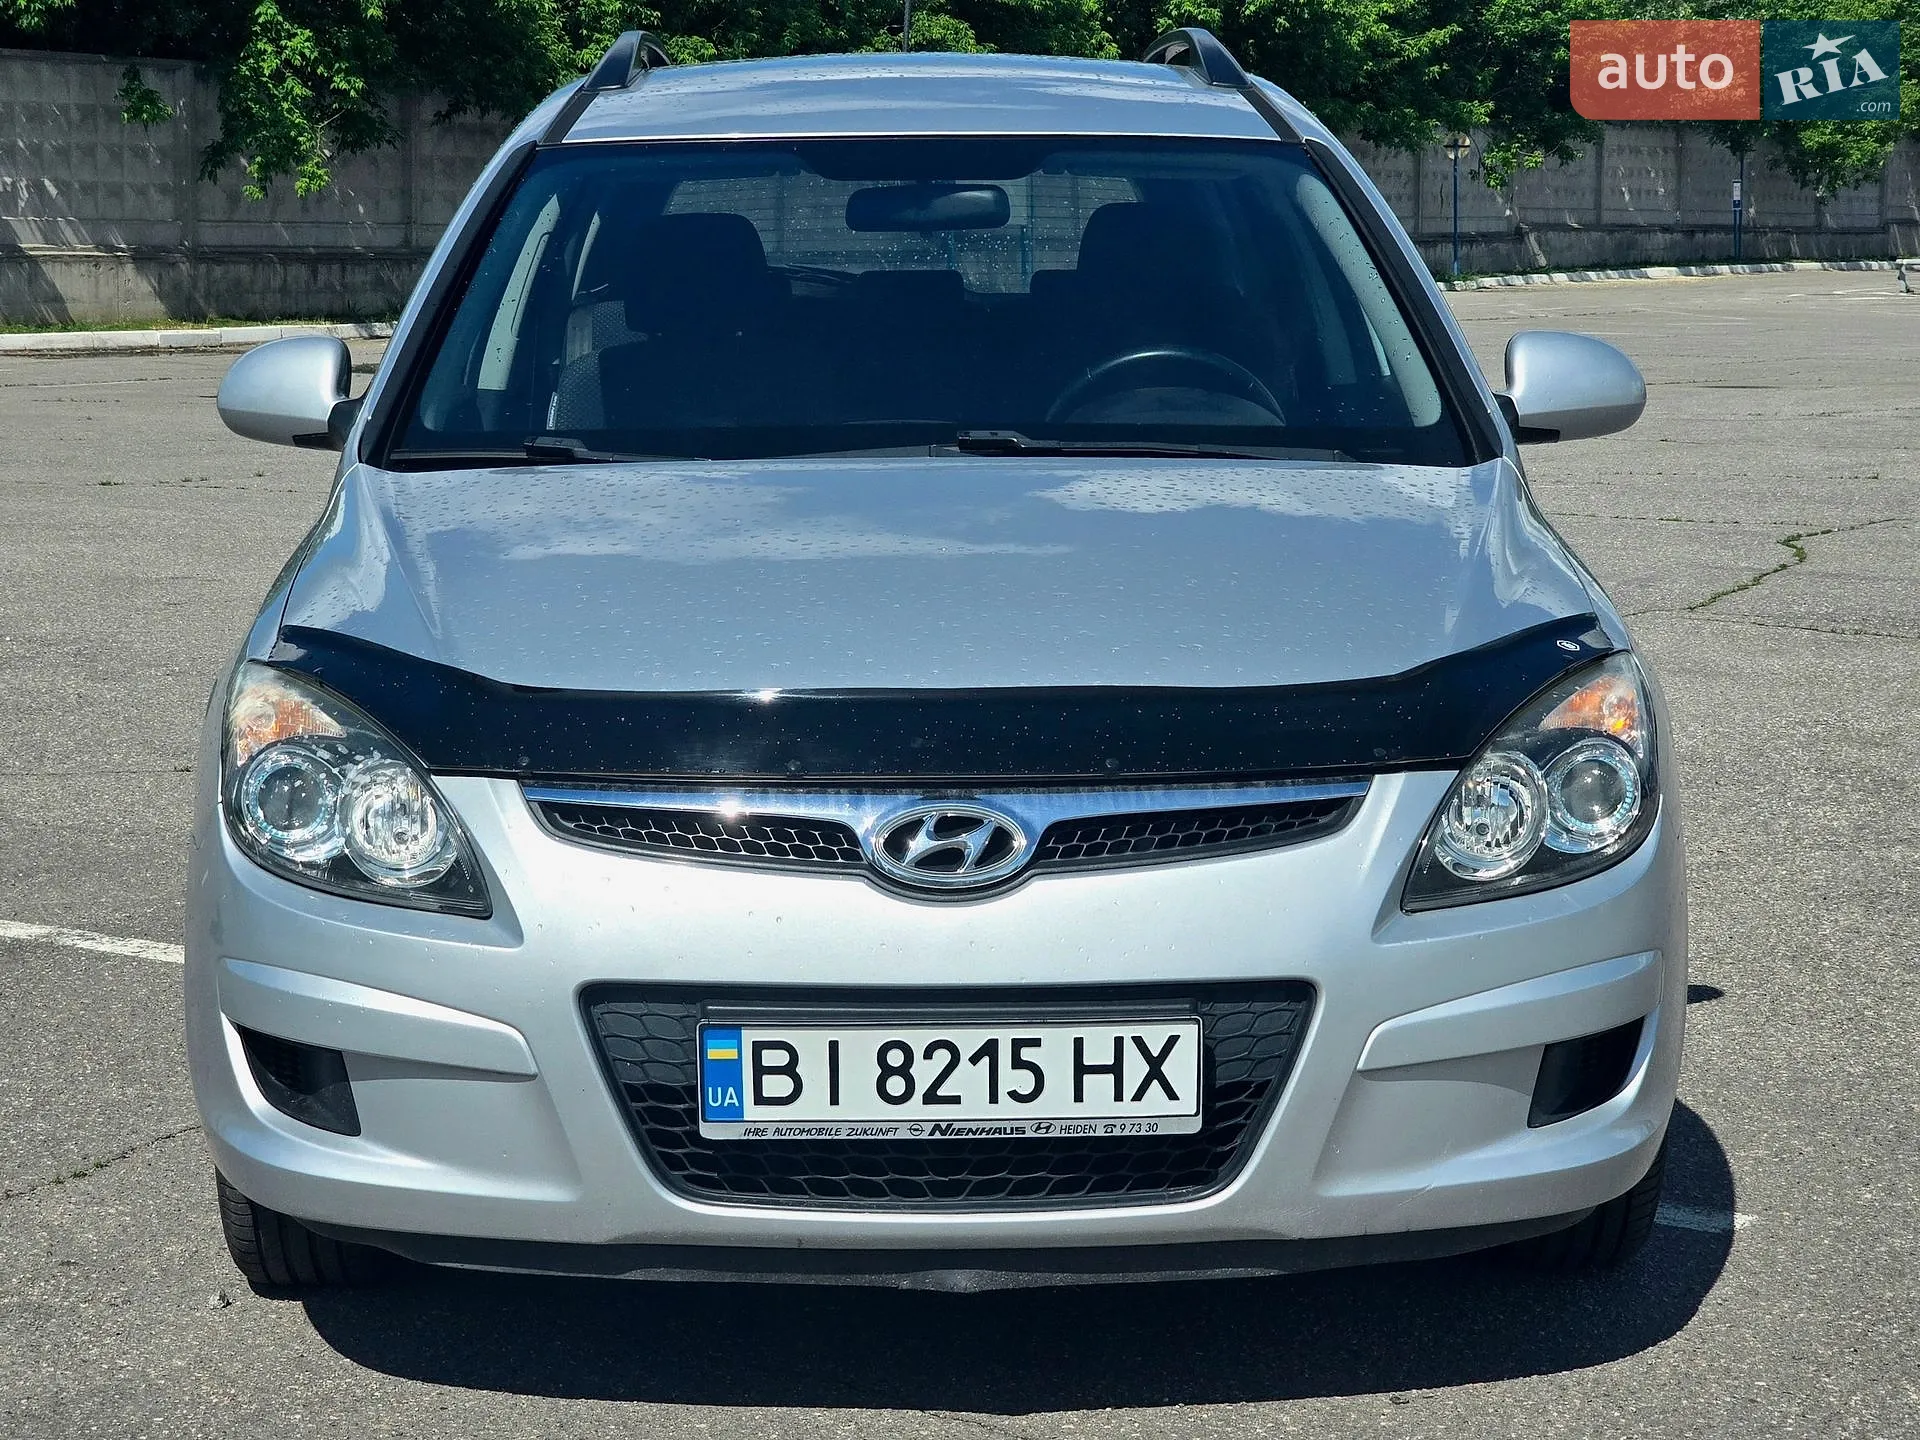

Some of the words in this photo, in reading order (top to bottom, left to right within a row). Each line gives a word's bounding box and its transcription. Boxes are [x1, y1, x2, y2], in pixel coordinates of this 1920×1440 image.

[750, 1039, 841, 1107] BI
[875, 1037, 1046, 1106] 8215
[1073, 1034, 1182, 1104] HX
[708, 1087, 739, 1107] UA
[743, 1127, 769, 1138] IHRE
[772, 1127, 843, 1138] AUTOMOBILE
[846, 1126, 900, 1137] ZUKUNFT
[927, 1122, 1026, 1137] NIENHAUS
[1059, 1123, 1098, 1135] HEIDEN
[1119, 1122, 1127, 1134] 9
[1128, 1122, 1142, 1134] 73
[1145, 1122, 1159, 1133] 30
